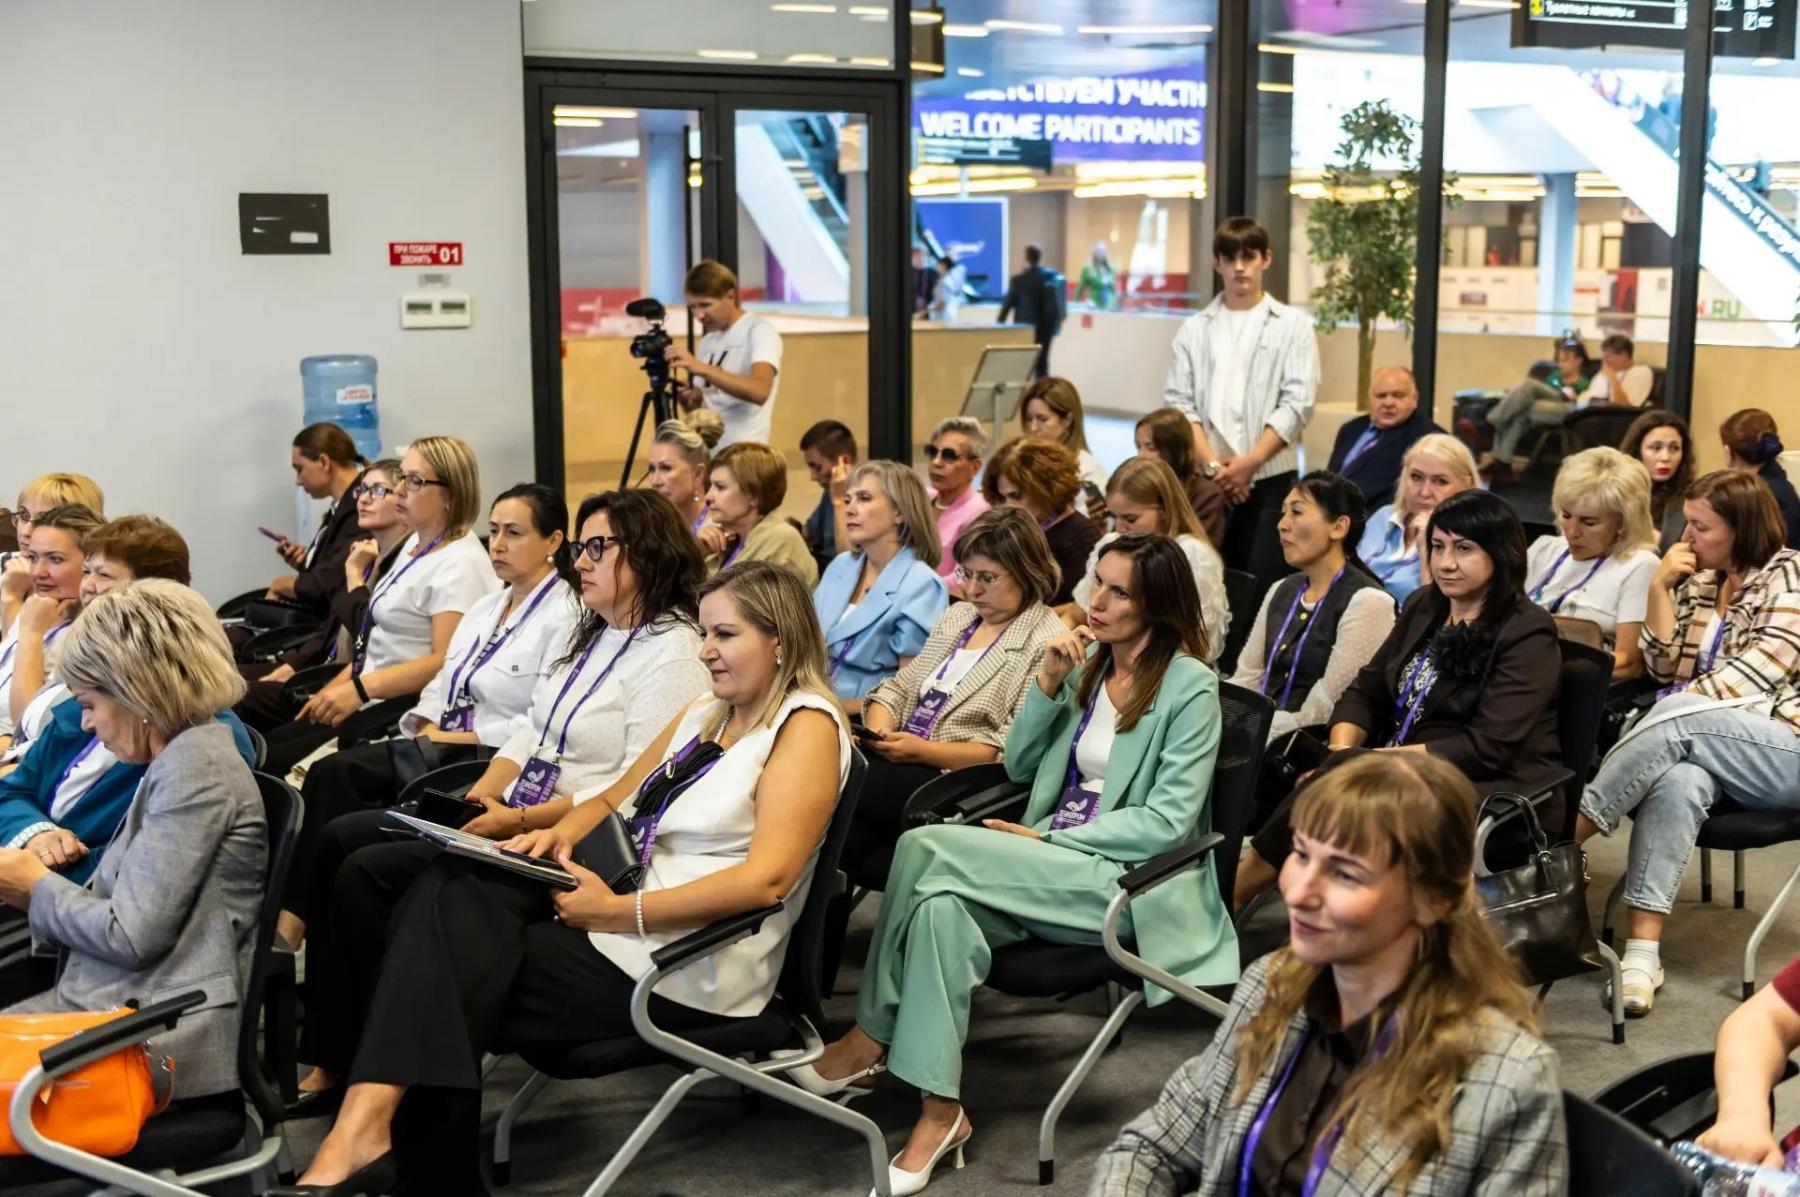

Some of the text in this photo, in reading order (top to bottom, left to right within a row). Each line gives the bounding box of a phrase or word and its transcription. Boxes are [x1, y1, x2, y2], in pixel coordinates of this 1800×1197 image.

[920, 111, 1201, 144] WELCOME PARTICIPANTS
[393, 244, 438, 255] ПРИ ПОЖАРЕ
[439, 246, 460, 264] 01
[400, 254, 433, 265] ЗВОНИТЬ
